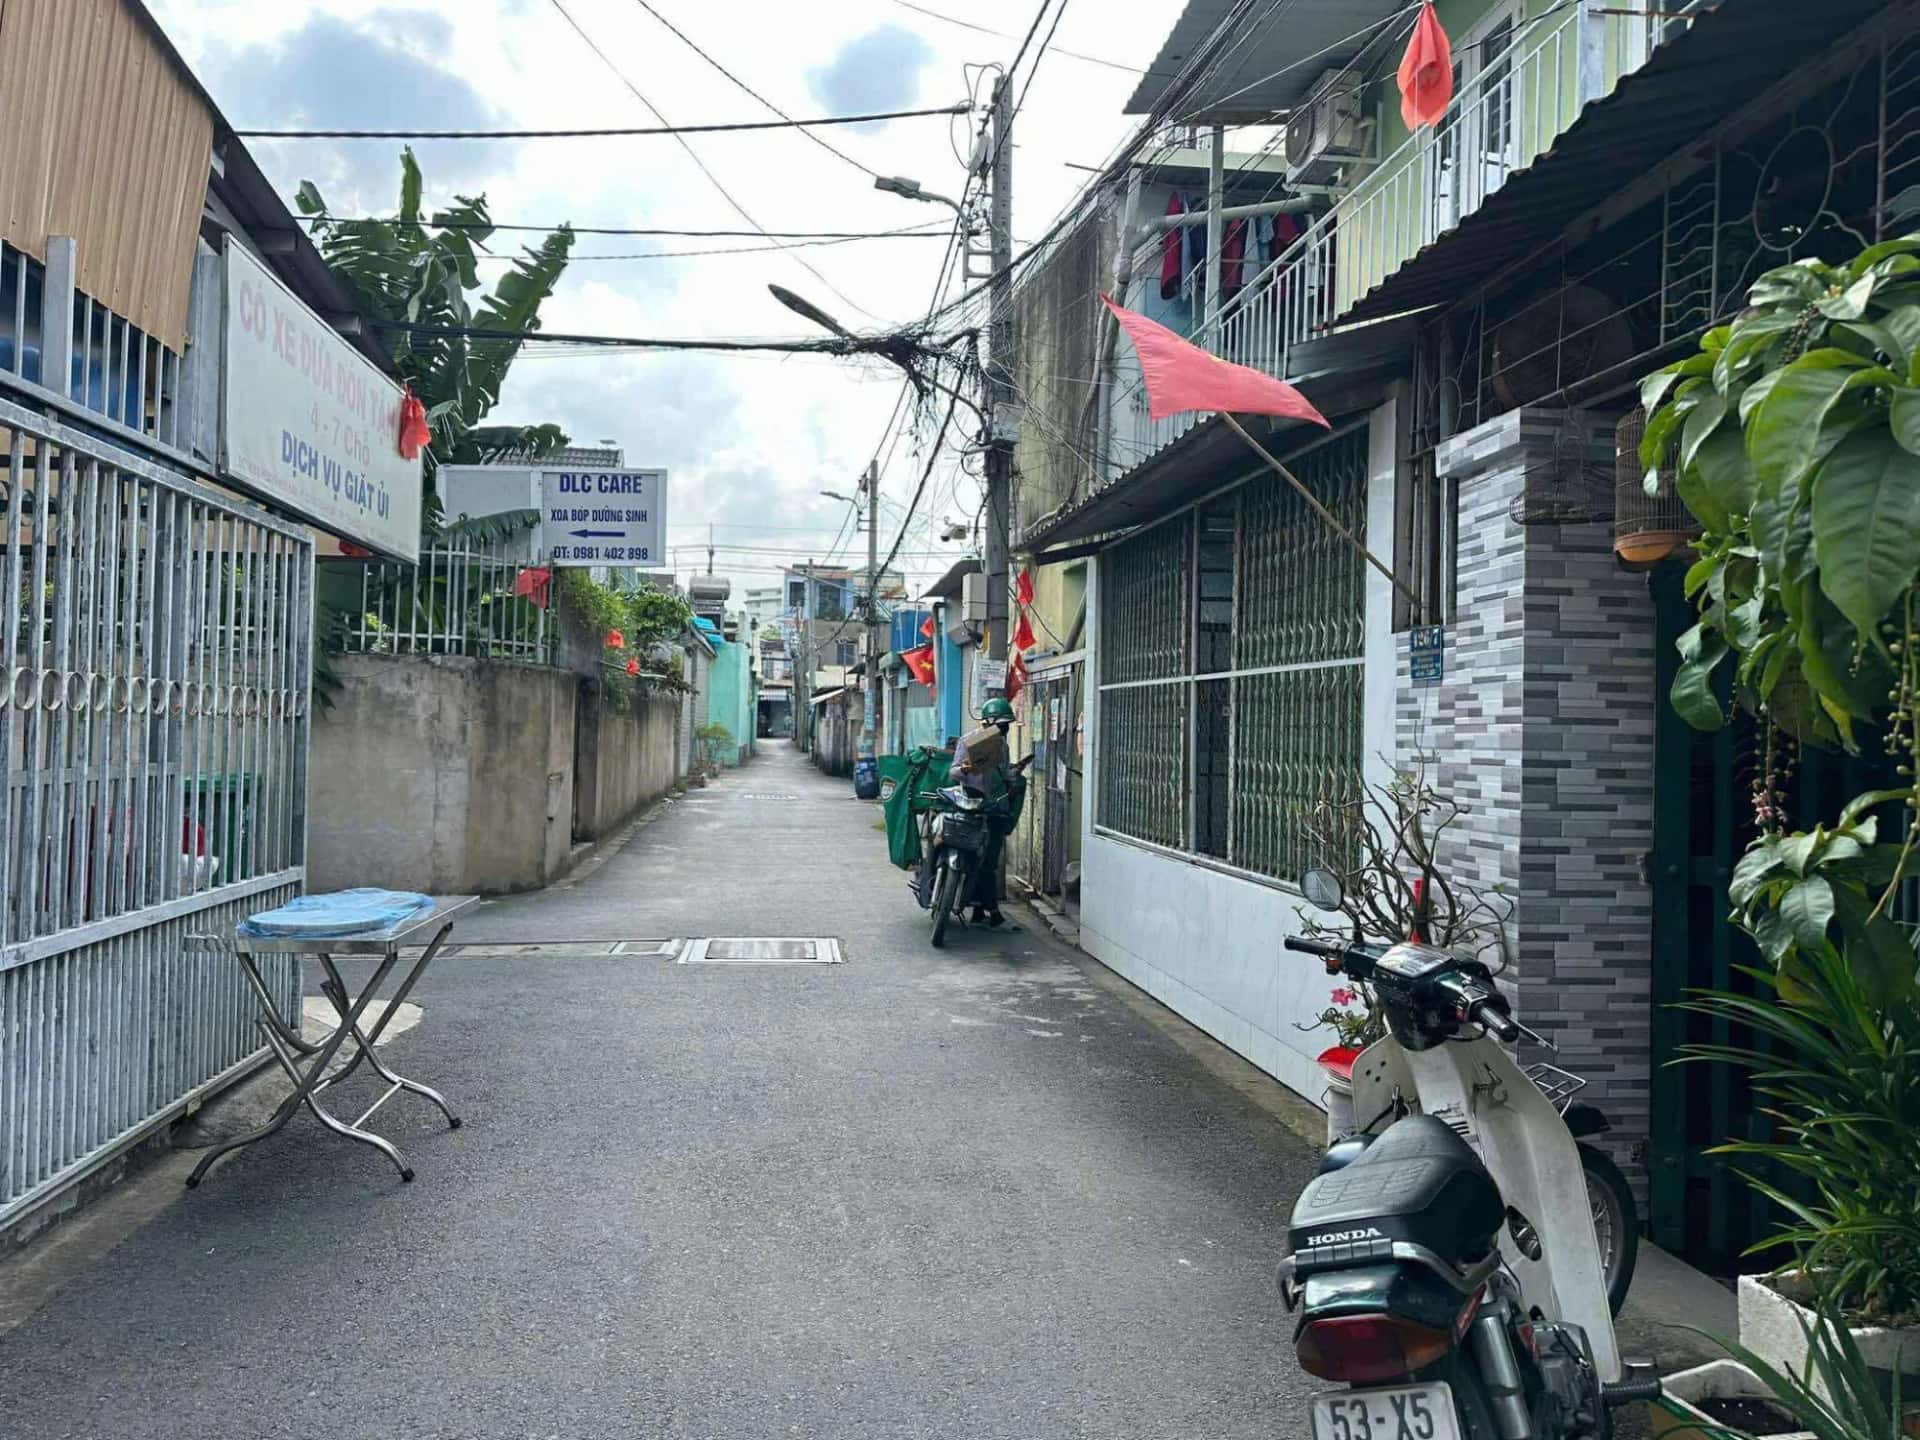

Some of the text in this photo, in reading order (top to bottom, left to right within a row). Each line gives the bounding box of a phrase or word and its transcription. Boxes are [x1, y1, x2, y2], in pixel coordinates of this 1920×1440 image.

[273, 307, 296, 368] XE
[311, 403, 319, 432] 4
[333, 415, 341, 446] 7
[282, 428, 318, 481] DỊCH
[322, 455, 341, 501] VỤ
[345, 471, 375, 516] GIẶT
[378, 481, 389, 521] ỦI
[560, 474, 642, 494] DLC CARE
[551, 509, 568, 522] XOA
[571, 506, 589, 522] BÓP
[626, 510, 648, 522] SINH
[573, 547, 599, 560] 0981
[604, 547, 625, 560] 402
[628, 548, 648, 560] 898
[1307, 1227, 1382, 1246] HONDA
[1329, 1392, 1435, 1440] 53-X5
